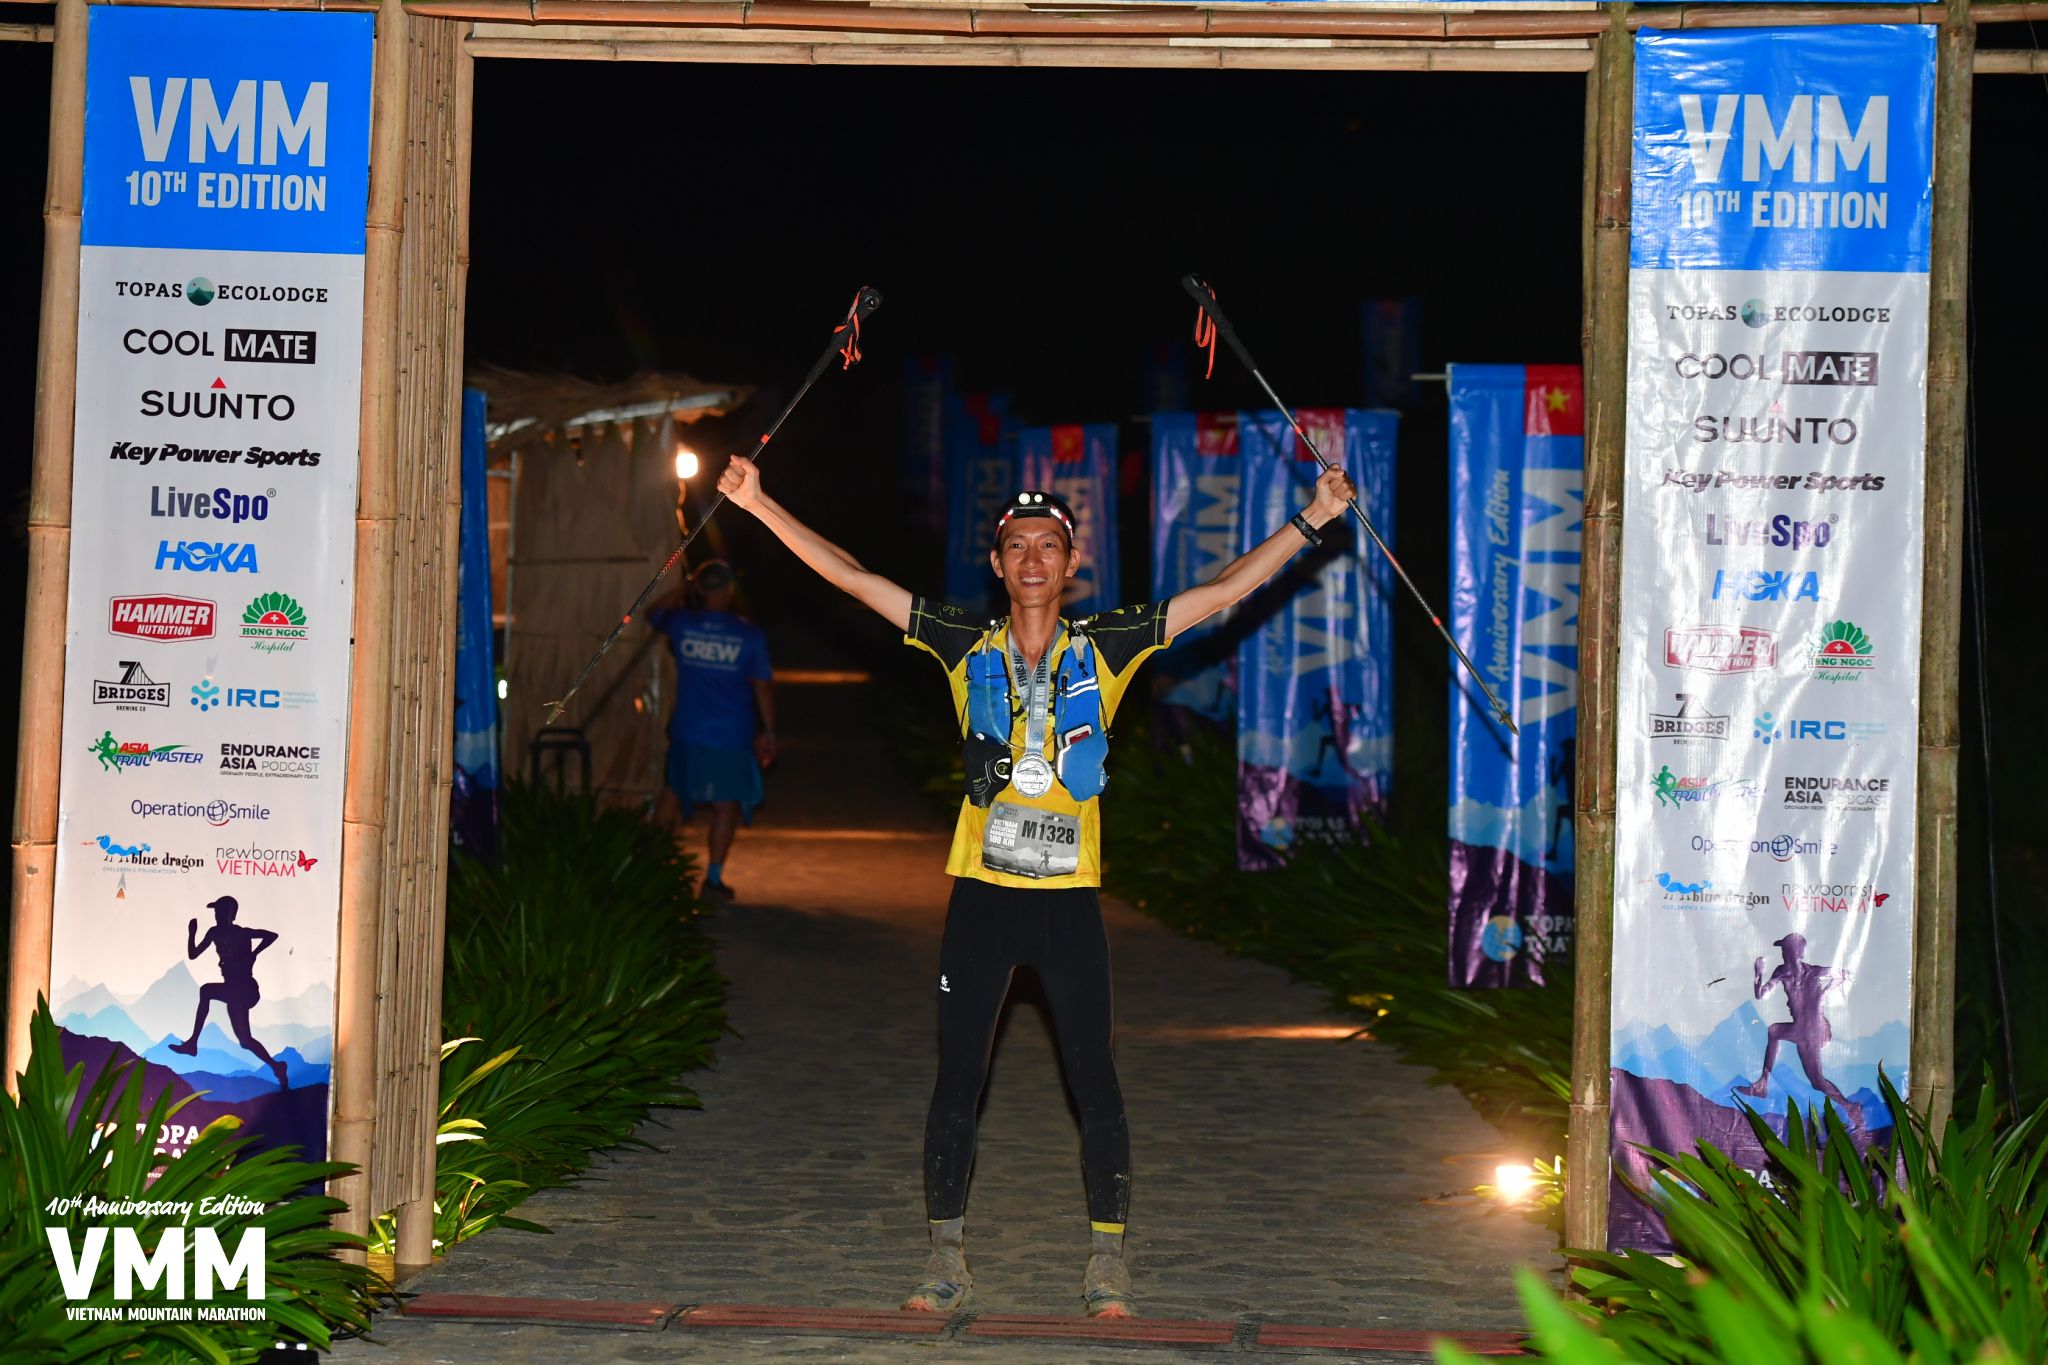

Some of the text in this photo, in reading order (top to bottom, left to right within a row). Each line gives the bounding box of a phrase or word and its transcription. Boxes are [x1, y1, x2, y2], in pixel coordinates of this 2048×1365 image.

[129, 76, 328, 167] VMM
[1679, 94, 1889, 183] VMM
[126, 170, 326, 212] 10TH EDITION
[1678, 190, 1888, 229] 10TH EDITION
[116, 281, 328, 302] TOPAS ECOLODGE
[1667, 305, 1890, 323] TOPAS ECOLODGE
[123, 329, 308, 360] COOL MATE
[1675, 352, 1870, 382] COOL MATE
[140, 390, 295, 421] SUUNTO
[1695, 415, 1857, 445] SUUNTO
[110, 442, 321, 468] Key Power Sports
[1662, 468, 1885, 494] Key Power Sports
[1484, 469, 1512, 547] Edition
[154, 540, 258, 573] HOKA
[1712, 570, 1821, 602] HOKA
[1522, 468, 1584, 727] VMM
[115, 603, 210, 626] HAMMER
[1486, 552, 1521, 682] Anniversary
[137, 624, 193, 637] NUTRITION
[242, 627, 306, 638] HONG NGOC
[251, 641, 295, 654] Hospital
[681, 638, 742, 662] CREW
[119, 661, 137, 684] 7
[1841, 658, 1872, 667] NGOC
[1814, 671, 1861, 685] Hospital
[98, 686, 165, 702] BRIDGES
[227, 688, 280, 709] IRC
[1035, 686, 1045, 703] KM
[1033, 705, 1044, 721] 100
[1654, 719, 1724, 735] BRIDGES
[1790, 720, 1846, 740] IRC
[119, 743, 149, 754] ASIA
[220, 743, 320, 759] ENDURANCE
[220, 757, 320, 773] ASIA PODCAST
[1785, 777, 1889, 791] ENDURANCE
[1784, 791, 1823, 803] ASIA
[131, 799, 270, 821] Operation Smile
[994, 818, 1018, 828] VIETNAM
[1021, 819, 1075, 845] M1328
[216, 842, 296, 861] newborns
[990, 835, 1015, 847] 100 KM
[1794, 842, 1838, 855] Smie
[131, 850, 204, 873] blue dragon
[217, 859, 296, 877] VIETNAM
